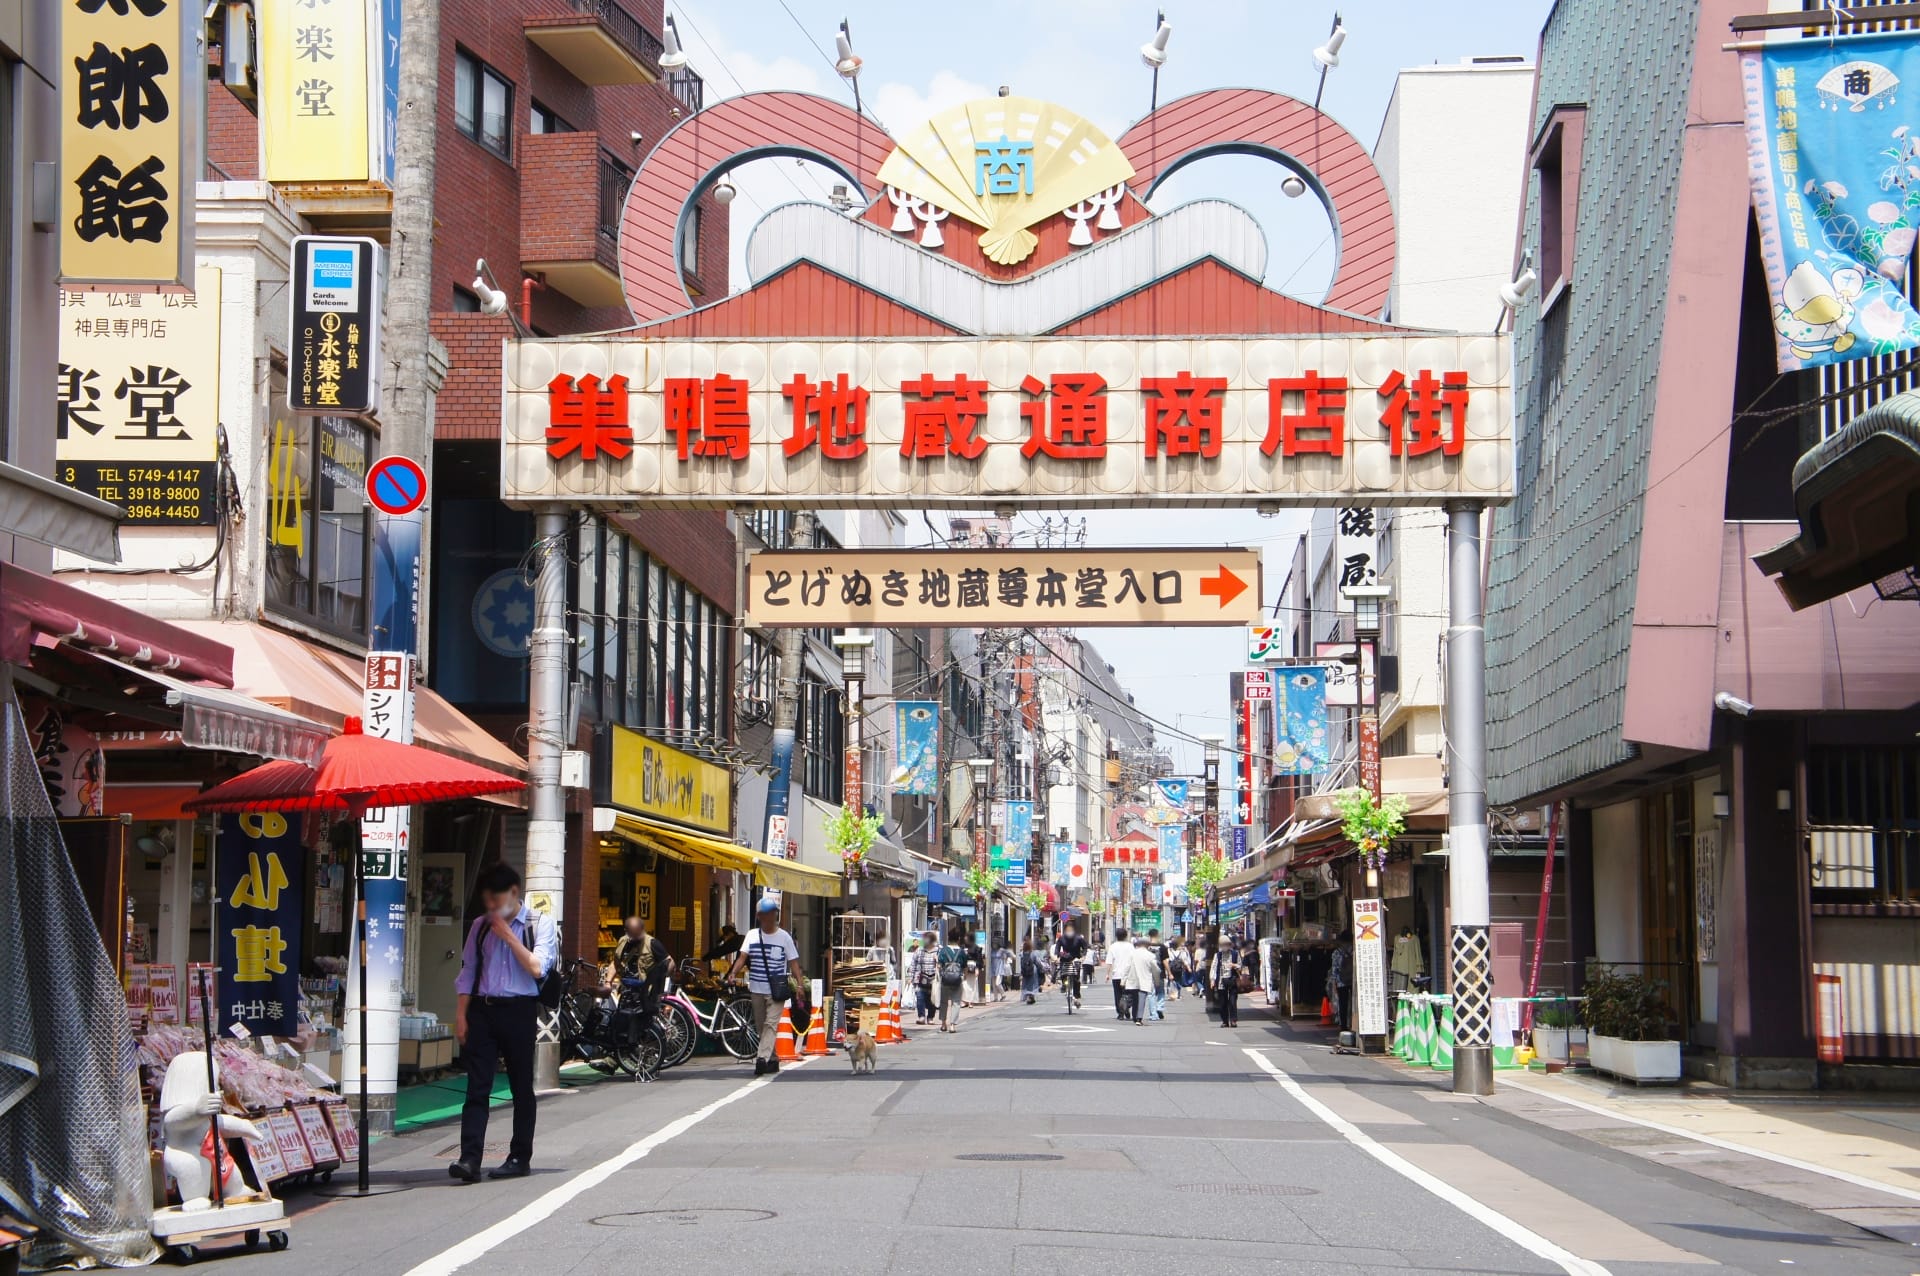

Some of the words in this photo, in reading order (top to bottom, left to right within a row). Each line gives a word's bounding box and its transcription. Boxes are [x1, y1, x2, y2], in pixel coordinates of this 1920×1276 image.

[295, 0, 335, 117] 楽堂
[1844, 70, 1872, 96] 商
[74, 0, 170, 244] 郎飴
[974, 134, 1035, 197] 商
[314, 262, 351, 270] AMERICAN
[321, 270, 352, 278] EXPRESS
[163, 293, 198, 309] 仏具
[313, 299, 348, 307] Welcome
[74, 318, 167, 338] 神具専門店
[317, 332, 341, 405] 永楽堂
[545, 369, 1469, 462] 巣鴨地蔵通商店街
[321, 430, 365, 478] EIRAKUDO
[97, 469, 123, 482] TEL
[128, 469, 200, 482] 5749-4147
[269, 419, 303, 558] 仏
[97, 487, 123, 500] TEL
[128, 487, 200, 500] 3918-9800
[127, 505, 200, 518] 3964-4450
[763, 567, 1182, 608] とげぬき地蔵尊本堂入口
[1234, 775, 1250, 820] 矢崎
[370, 831, 394, 840] この先
[1235, 829, 1243, 859] 大正大学
[1356, 902, 1378, 913] ご注意
